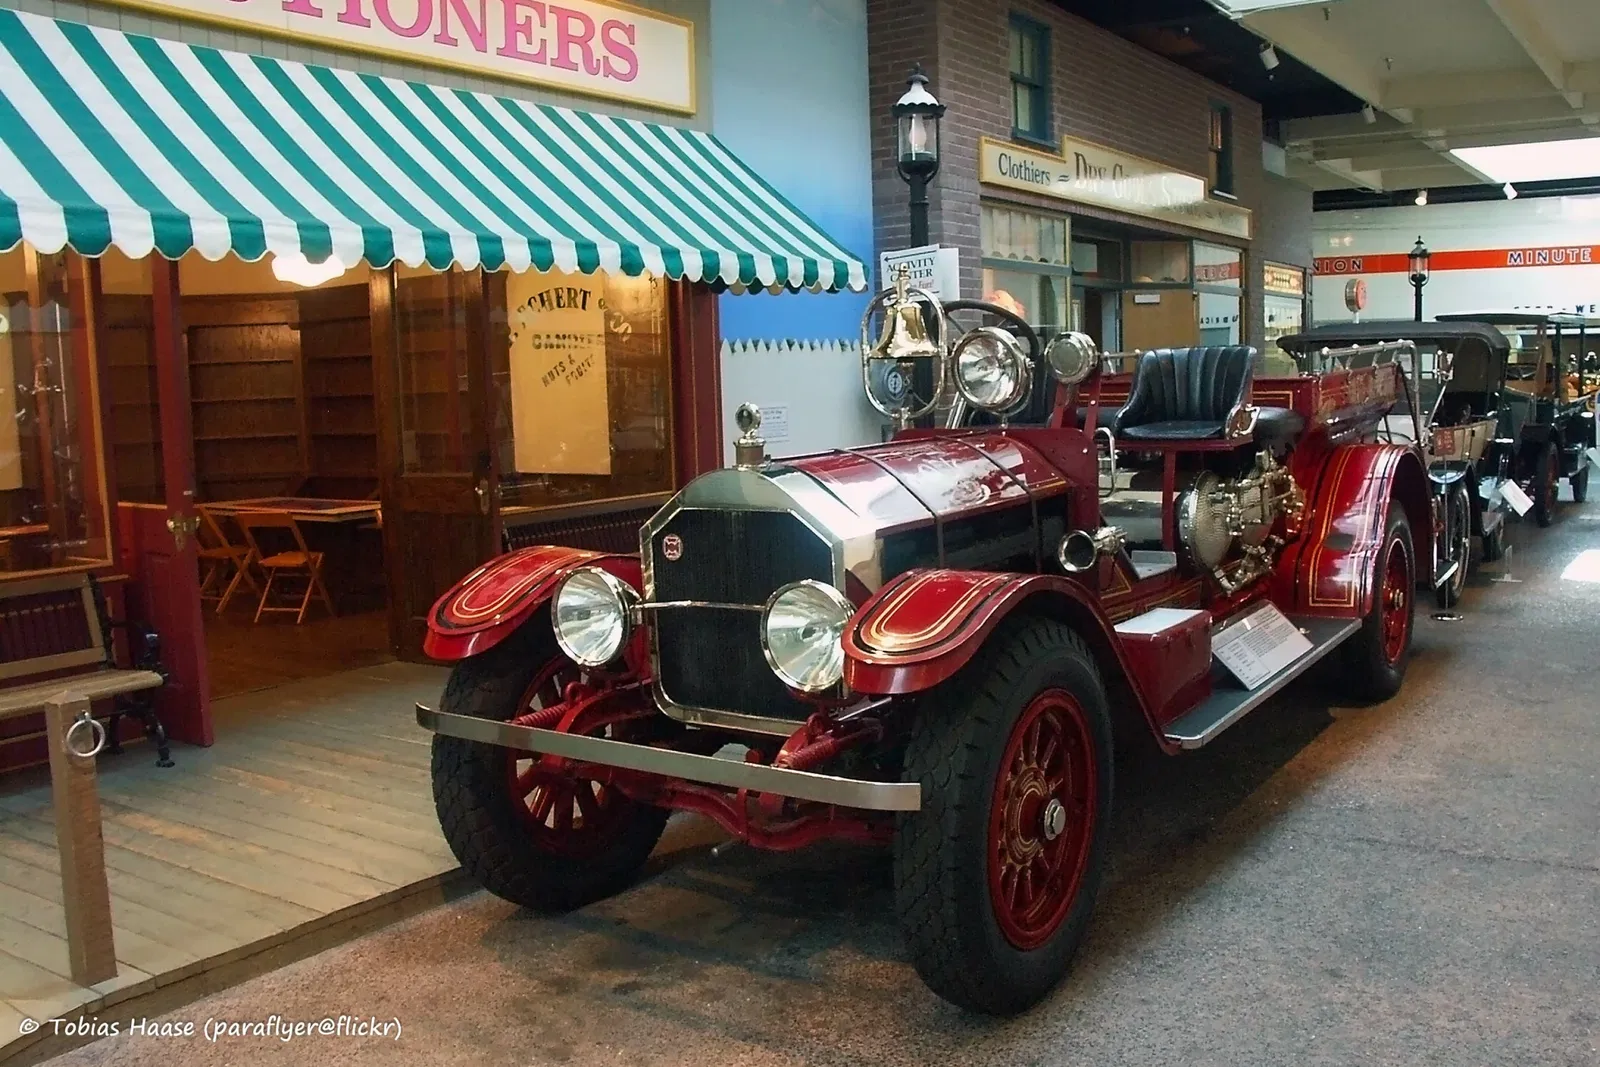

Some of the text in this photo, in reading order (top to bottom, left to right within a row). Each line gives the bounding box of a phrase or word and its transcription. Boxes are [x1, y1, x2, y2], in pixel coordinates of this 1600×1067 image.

[229, 0, 638, 82] ONERS
[999, 152, 1051, 187] Clothiers
[886, 257, 936, 273] ACIVITY
[1507, 248, 1592, 266] MINUTE
[890, 268, 933, 282] CTER
